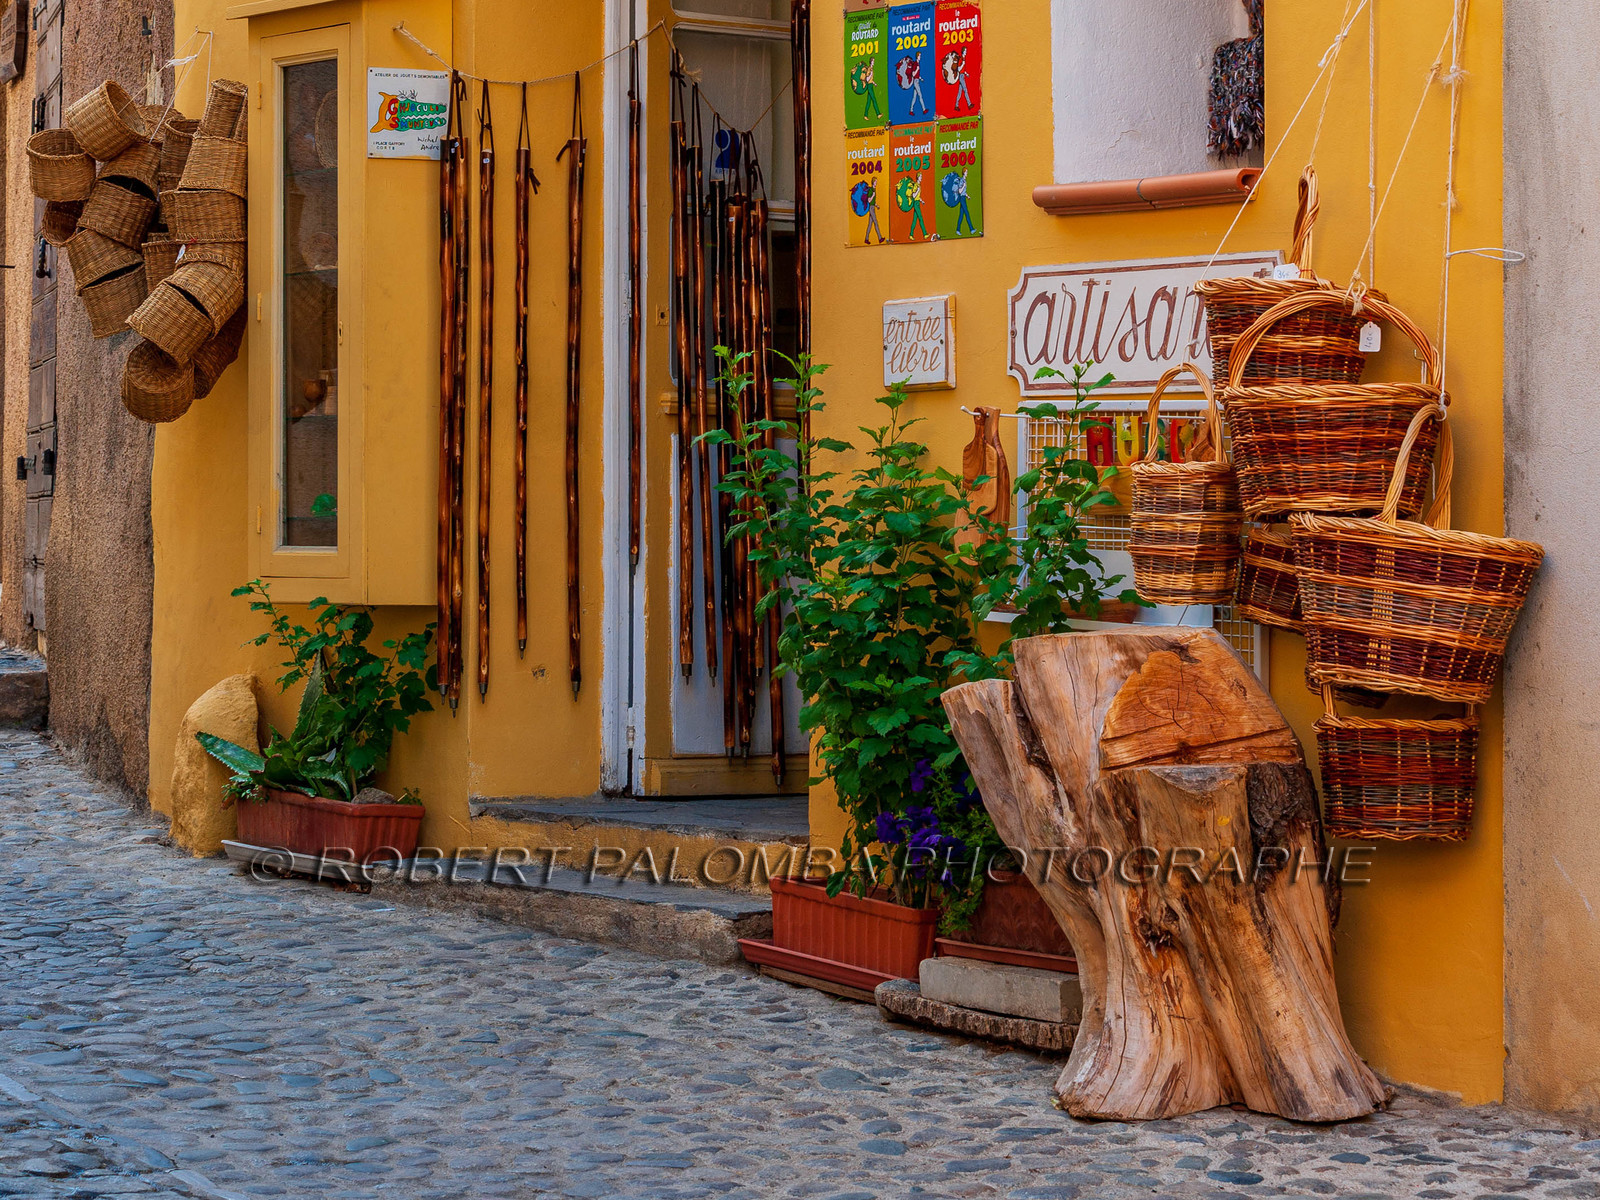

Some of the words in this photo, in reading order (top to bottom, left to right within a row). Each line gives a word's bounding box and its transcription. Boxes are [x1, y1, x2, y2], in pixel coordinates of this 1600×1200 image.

[891, 17, 931, 35] routard
[939, 14, 978, 32] routard
[851, 29, 879, 41] ROUTARD
[896, 34, 928, 50] 2002
[943, 29, 974, 45] 2003
[850, 41, 879, 57] 2001
[847, 144, 885, 160] routard
[894, 141, 932, 156] routard
[940, 136, 977, 152] routard
[896, 155, 930, 172] 2005
[941, 150, 976, 168] 2006
[851, 160, 883, 175] 2004
[884, 306, 942, 344] entrée
[886, 341, 941, 374] libre
